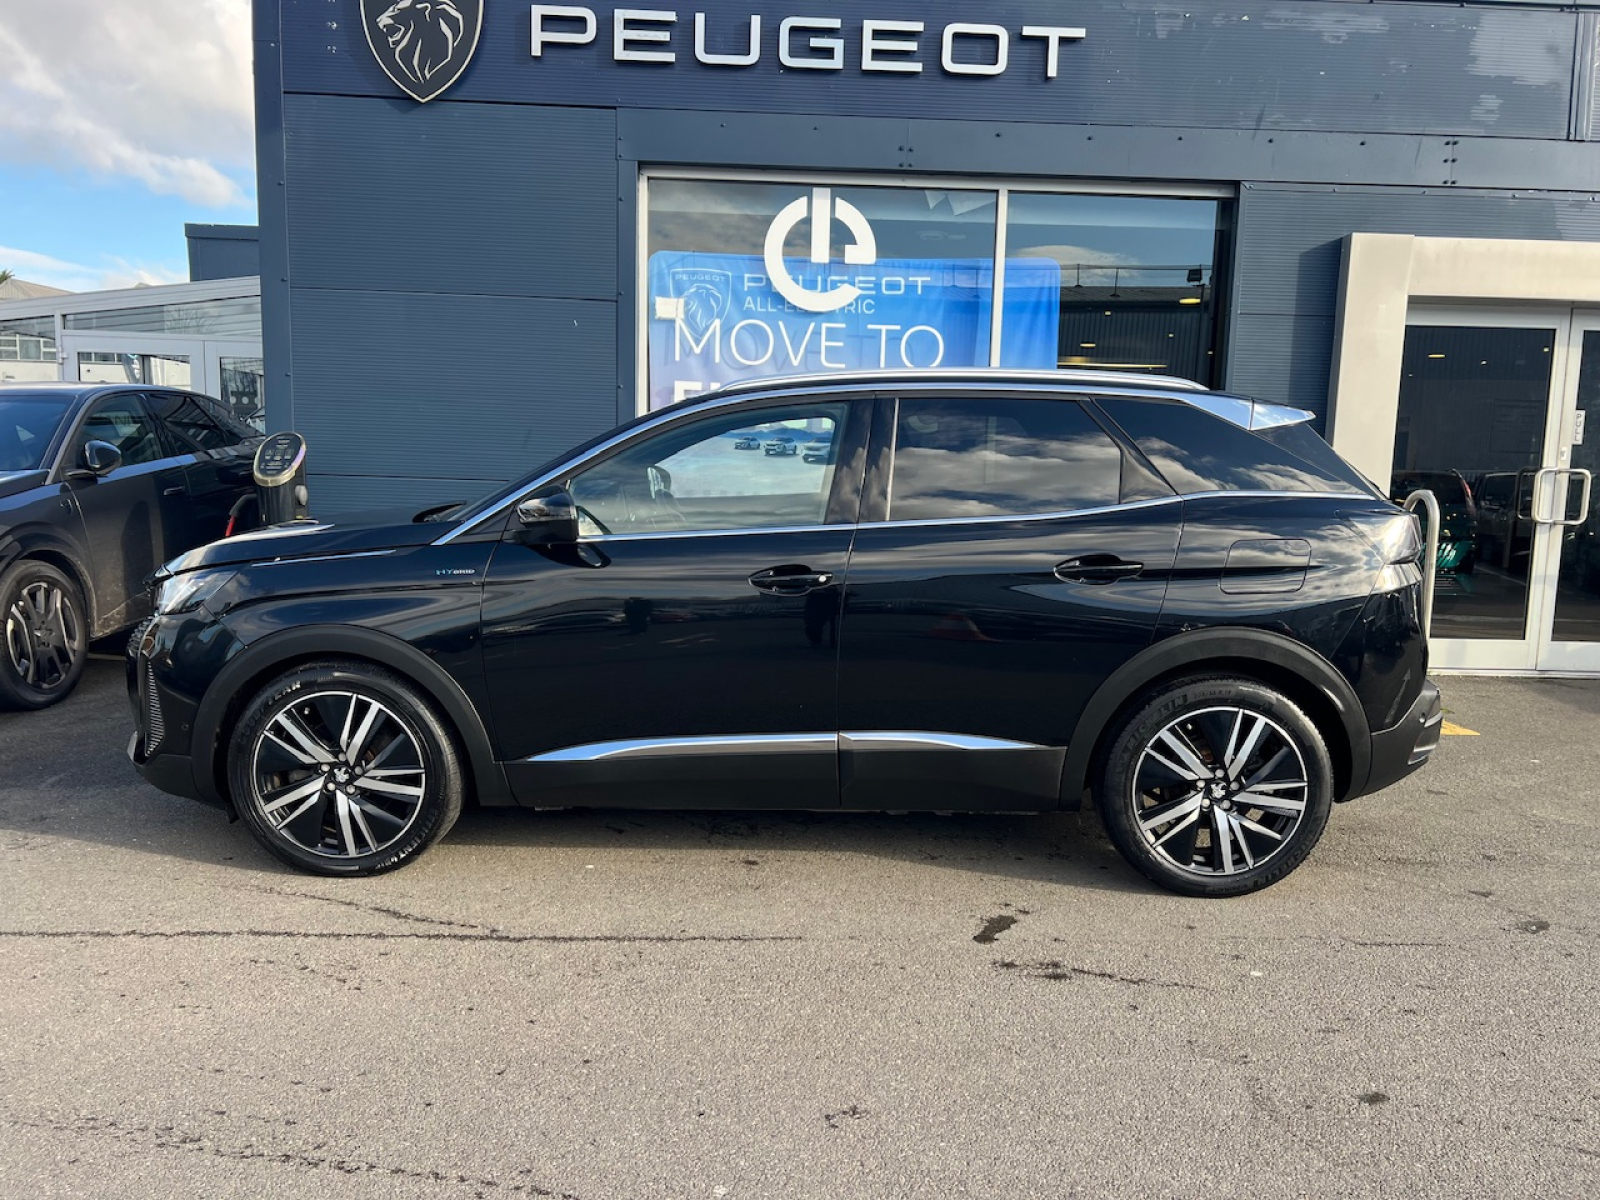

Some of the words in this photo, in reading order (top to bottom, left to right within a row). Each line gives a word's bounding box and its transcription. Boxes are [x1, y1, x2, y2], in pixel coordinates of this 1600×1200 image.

[530, 4, 1086, 78] PEUGEOT
[675, 273, 726, 282] PEUGEOT
[744, 273, 931, 295] PUGEOT
[674, 319, 846, 368] MOVE
[867, 324, 945, 368] TO
[1574, 413, 1582, 442] PULL
